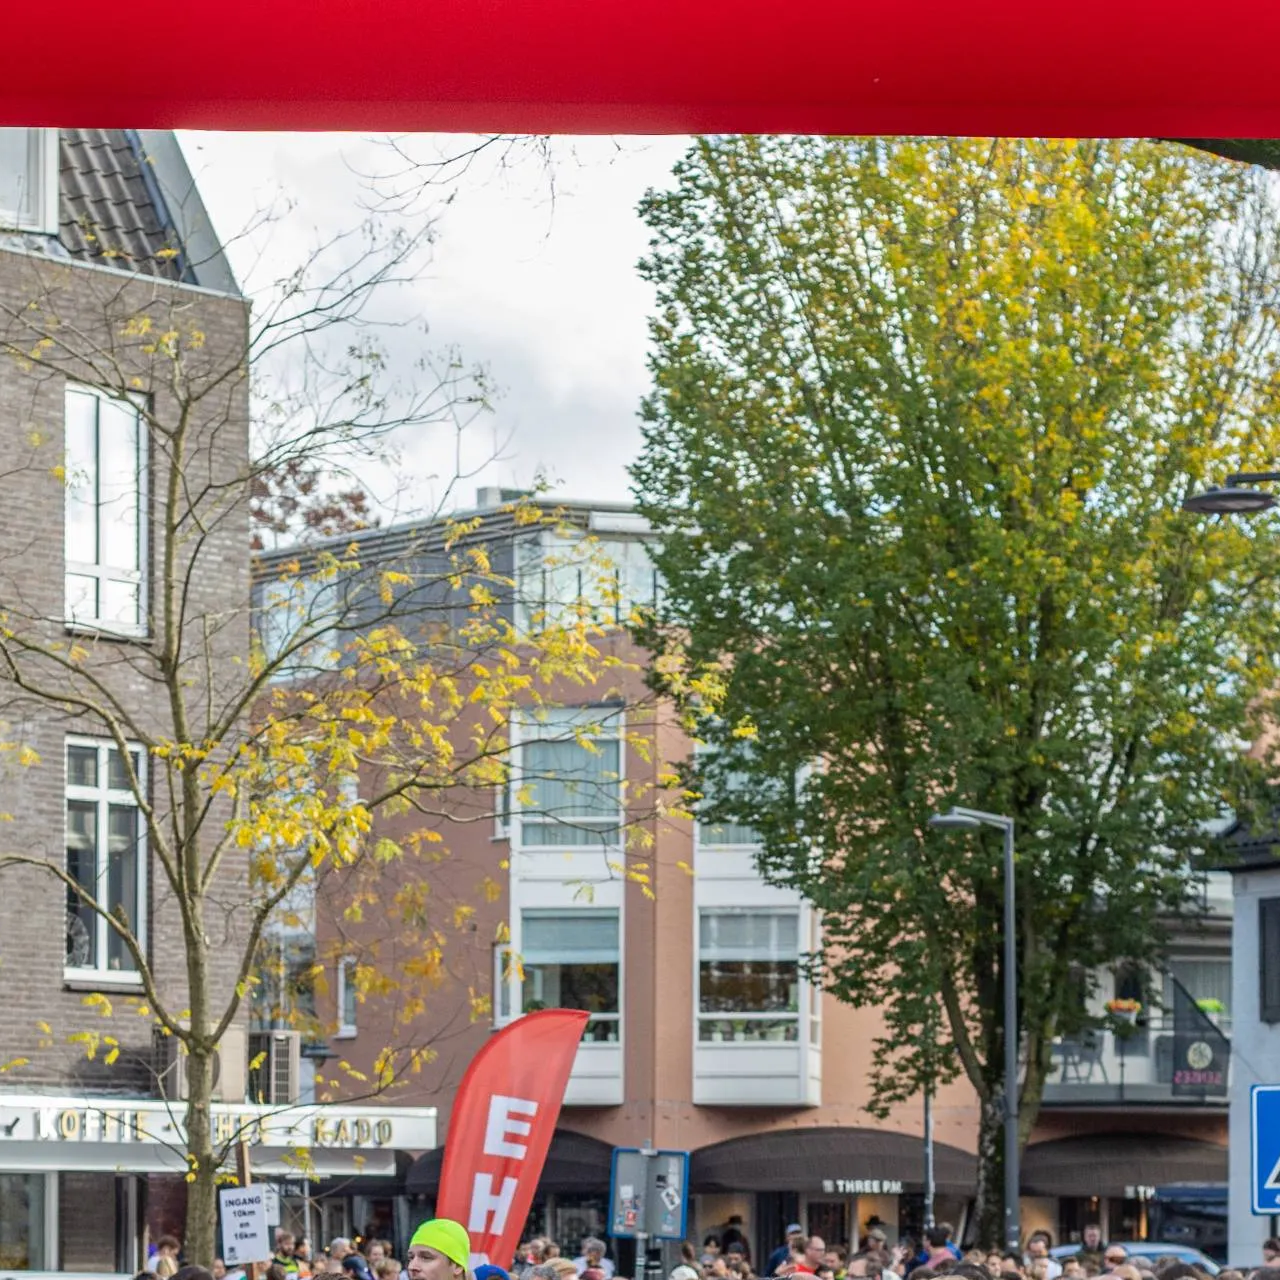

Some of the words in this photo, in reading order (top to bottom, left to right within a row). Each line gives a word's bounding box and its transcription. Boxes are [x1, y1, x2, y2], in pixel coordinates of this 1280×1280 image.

[38, 1107, 151, 1140] KOFFIE
[217, 1114, 272, 1144] HEE
[315, 1117, 392, 1146] KADO
[836, 1180, 880, 1193] THREE
[225, 1196, 261, 1207] INGANG
